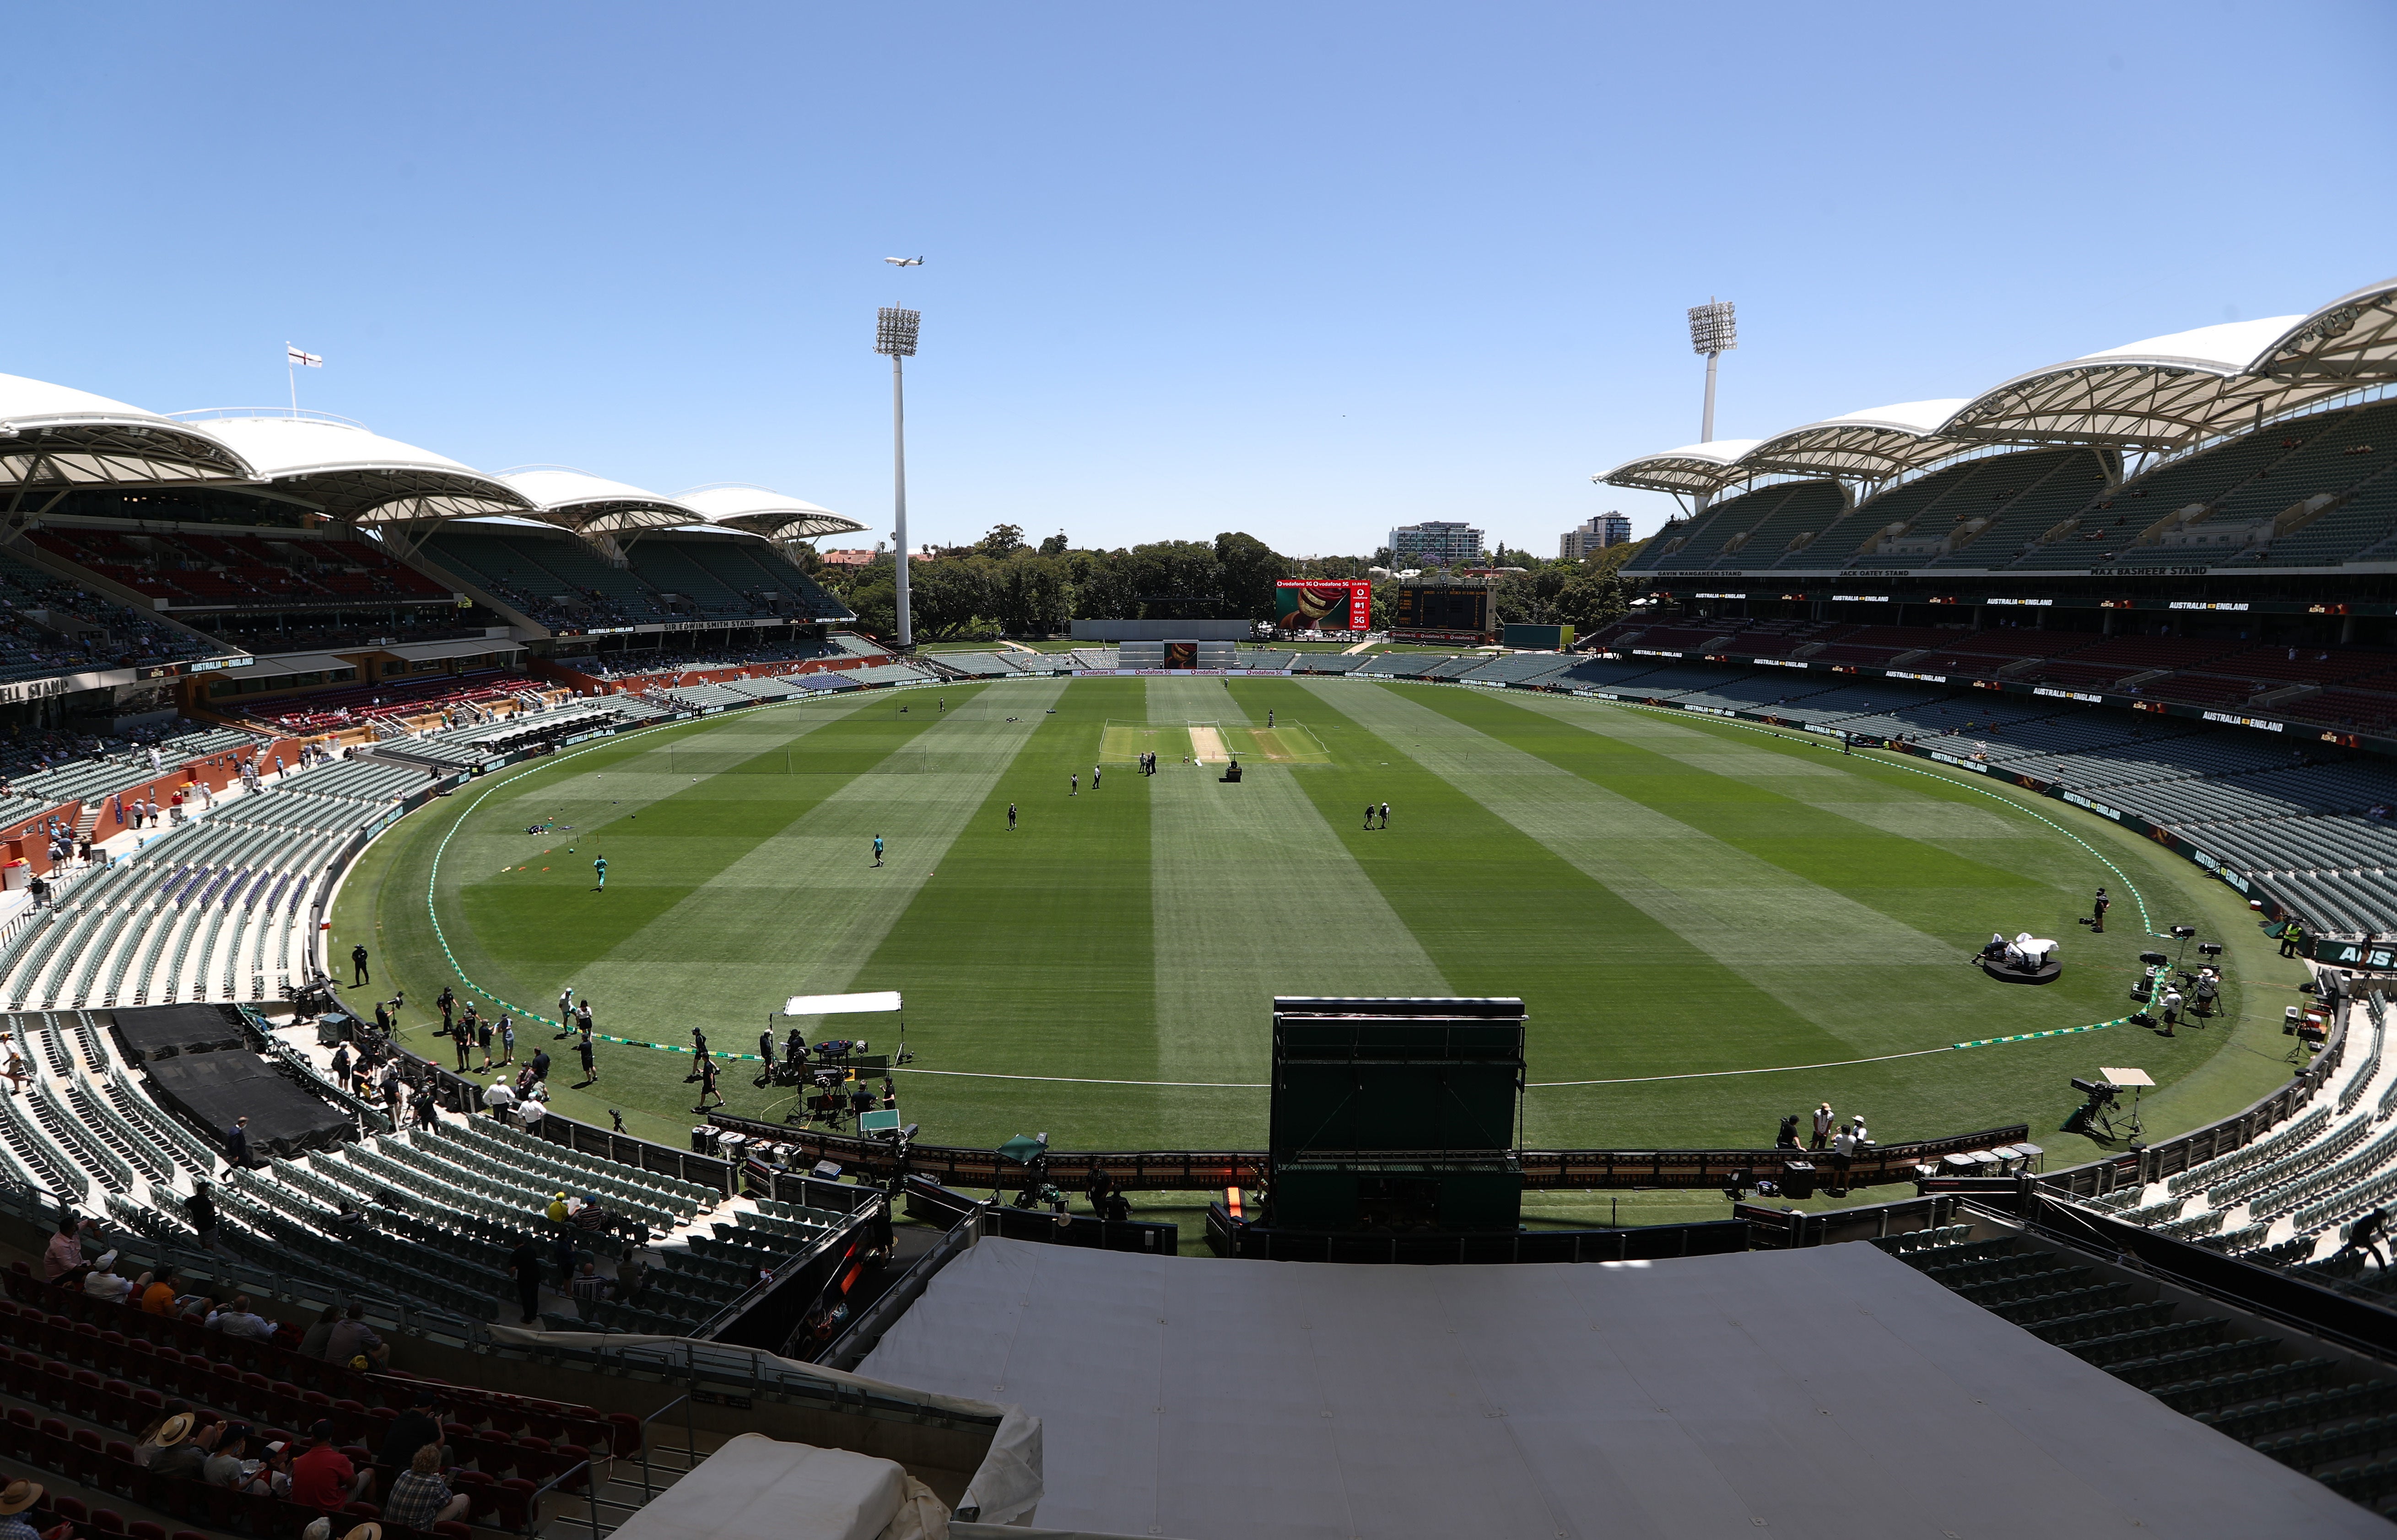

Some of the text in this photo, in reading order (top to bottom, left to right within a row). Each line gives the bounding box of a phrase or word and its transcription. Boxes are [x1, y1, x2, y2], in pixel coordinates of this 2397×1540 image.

[2117, 566, 2166, 575] BASHEER
[2170, 566, 2206, 575] STAND
[191, 658, 254, 672] AUSTRALIA ENGLAND
[1885, 671, 1946, 683] AUSTRALIA ENGLAND
[28, 679, 68, 698] STAND
[2033, 688, 2102, 703] AUSTRALIA ENGLAND
[705, 705, 724, 714] ENGLAND
[1684, 704, 1708, 712] AUSTRALIA
[2203, 711, 2284, 732] AUSTRALIA ENGLAND
[1804, 724, 1830, 735] AUSTRALIA
[566, 734, 588, 746] AUSTRALIA
[486, 759, 505, 772] ENGLAND
[1931, 751, 1987, 773] AUSTRALIA ENGLAND
[2063, 791, 2121, 821] AUSTRALIA ENGLAND
[366, 806, 404, 840] AUSTRALIA ENGLAND
[2225, 867, 2249, 894] ENGLAND
